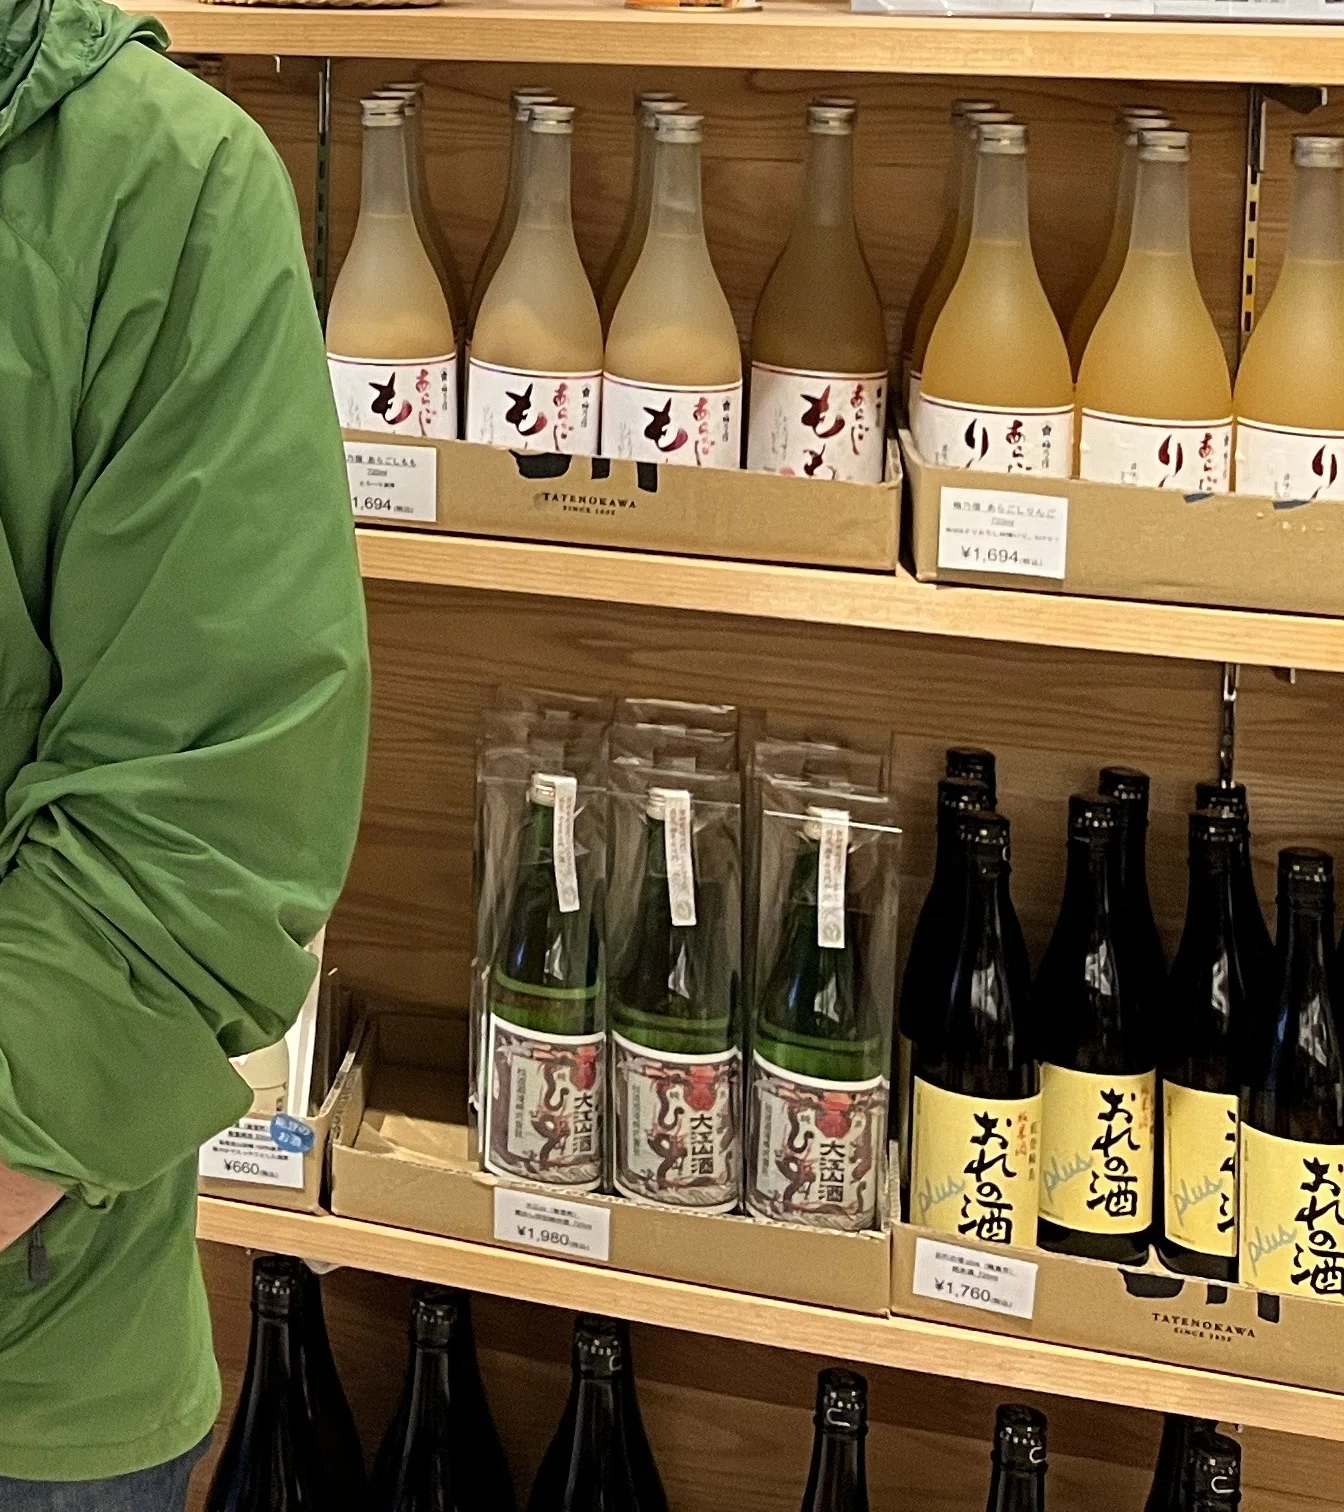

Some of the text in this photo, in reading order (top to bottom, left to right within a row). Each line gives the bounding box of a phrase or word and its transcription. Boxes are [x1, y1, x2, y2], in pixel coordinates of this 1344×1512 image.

[1158, 434, 1184, 488] り
[1312, 444, 1338, 500] り
[543, 491, 637, 509] TATENOKAWA
[961, 545, 1019, 565] ¥1,694
[224, 1159, 260, 1176] ¥660
[690, 1113, 714, 1175] 大江山酒
[1086, 1088, 1141, 1218] おれの酒
[818, 1140, 845, 1202] 大江山酒
[958, 1111, 1018, 1245] おれの酒
[1043, 1152, 1094, 1204] plus
[917, 1174, 966, 1226] plus
[1173, 1175, 1224, 1228] plus
[517, 1224, 570, 1246] ¥1,980
[1247, 1224, 1298, 1278] plus
[934, 1277, 991, 1303] ¥1,760
[1152, 1312, 1256, 1338] TATENOKAWA
